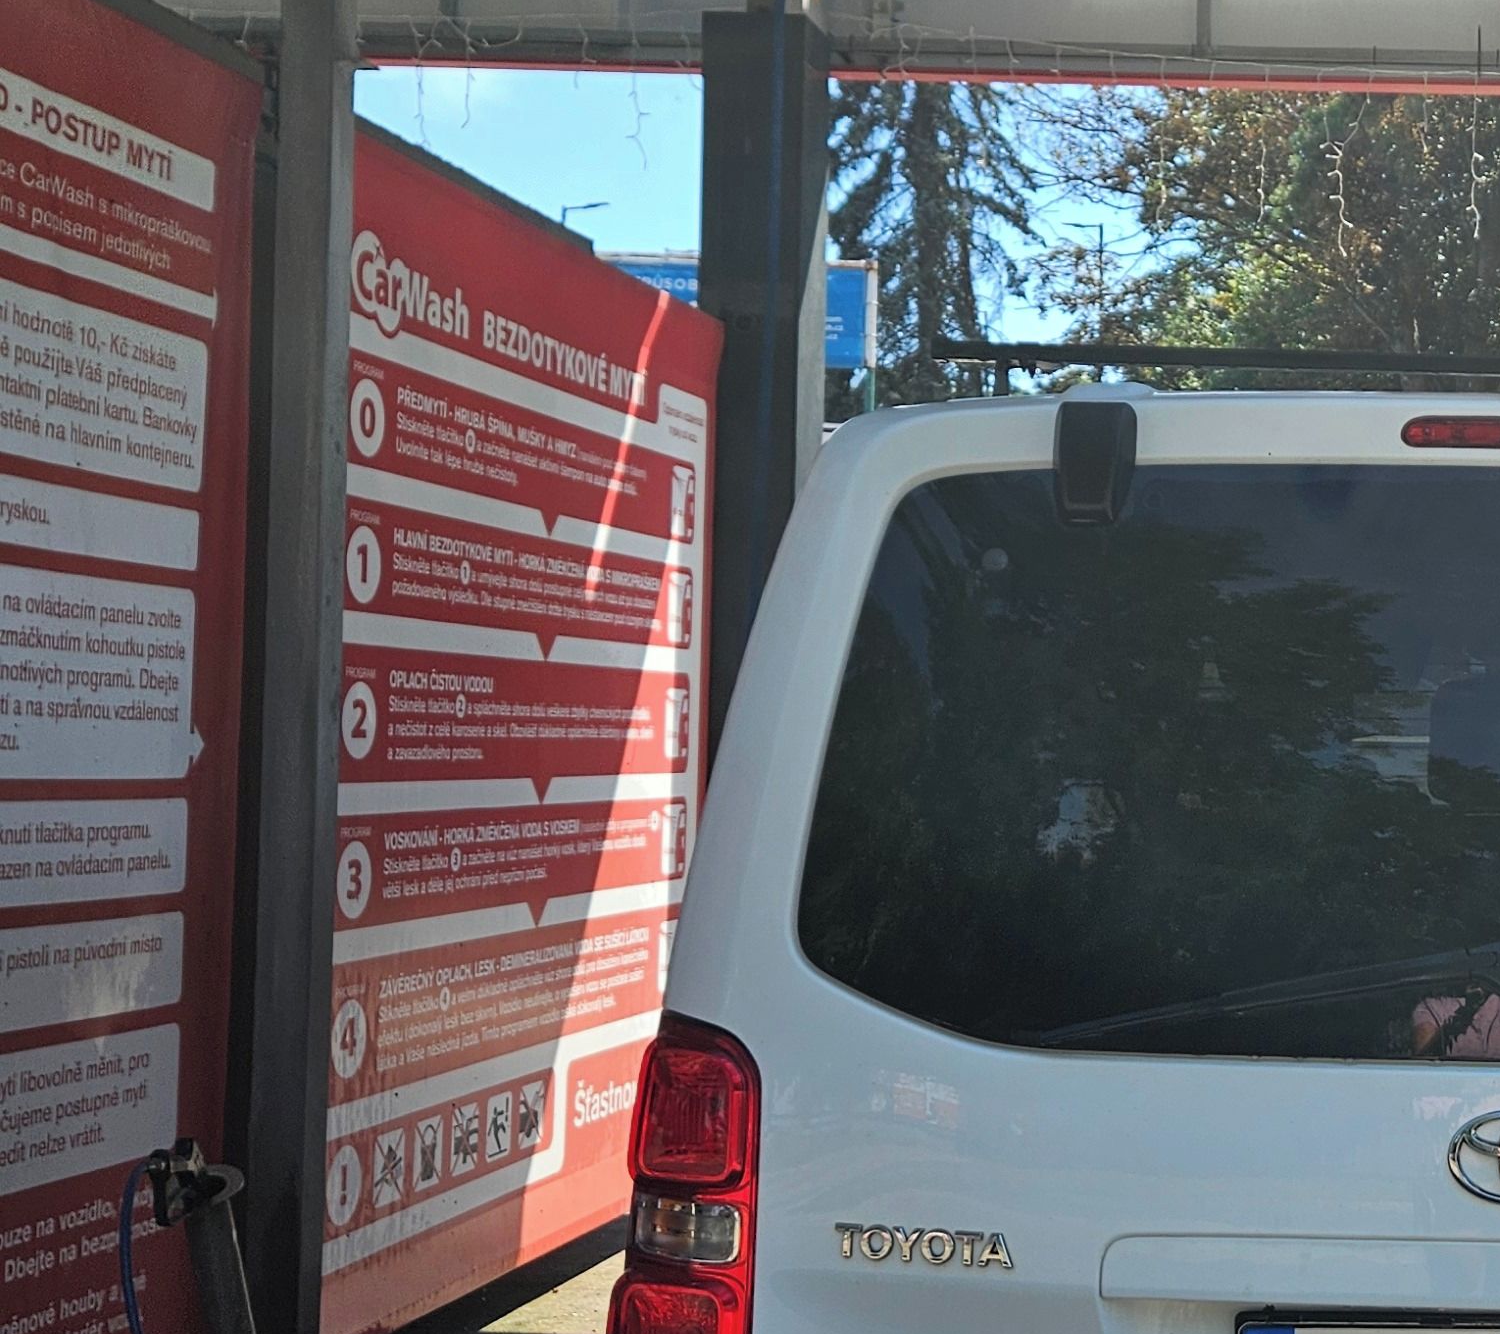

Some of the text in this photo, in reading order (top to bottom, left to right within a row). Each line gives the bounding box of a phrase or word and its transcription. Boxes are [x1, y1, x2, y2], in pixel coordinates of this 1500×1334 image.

[31, 96, 120, 156] POSTUP
[126, 138, 173, 181] MYTÍ
[20, 161, 94, 210] CarWash
[17, 202, 26, 218] s
[31, 205, 97, 243] popisem
[13, 303, 73, 341] hodnotě
[79, 325, 106, 354] 10,-
[110, 332, 128, 357] Kč
[355, 245, 469, 340] CarWash
[483, 310, 606, 393] BEZDOTYKOVÉ
[14, 343, 188, 410] použijte Váš předplacený
[45, 384, 100, 416] platební
[104, 397, 138, 425] kartu.
[142, 406, 198, 444] Bankovky
[397, 385, 448, 418] PŘEDMYTÍ
[454, 405, 485, 431] HRUBÁ
[45, 421, 195, 469] na hlavním kontejneru.
[357, 543, 368, 584] 1
[394, 527, 428, 550] HLAVNÍ
[429, 534, 493, 562] BEZDOTYKOVÉ
[3, 592, 182, 629] na ovládacím panelu zvolte
[85, 631, 144, 658] kohoutku
[147, 640, 186, 664] pistole
[66, 666, 136, 693] programů.
[139, 668, 179, 696] Dbejte
[389, 668, 494, 693] OPLACH ČISTOU VODOU
[13, 696, 179, 723] a na správnou vzdálenost
[351, 698, 368, 739] 2
[35, 821, 83, 845] tlačítka
[87, 822, 151, 848] programu.
[384, 824, 439, 851] VOSKOVÁNÍ
[443, 822, 475, 845] HORKÁ
[35, 860, 53, 878] na
[56, 853, 123, 878] ovládacím
[127, 849, 171, 878] panelu.
[346, 858, 363, 901] 3
[7, 943, 49, 977] pistoli
[53, 944, 70, 965] na
[74, 936, 127, 969] původní
[130, 934, 162, 955] místo
[378, 965, 435, 999] ZÁVĚREČNÝ
[339, 1016, 358, 1057] 4
[20, 1060, 82, 1095] libovolně
[128, 1052, 149, 1076] pro
[122, 1080, 147, 1113] mytí
[29, 1134, 66, 1158] nelze
[36, 1217, 54, 1238] na
[834, 1221, 1014, 1269] TOYOTA
[5, 1244, 77, 1283] Dbejte na
[60, 1288, 105, 1320] houby
